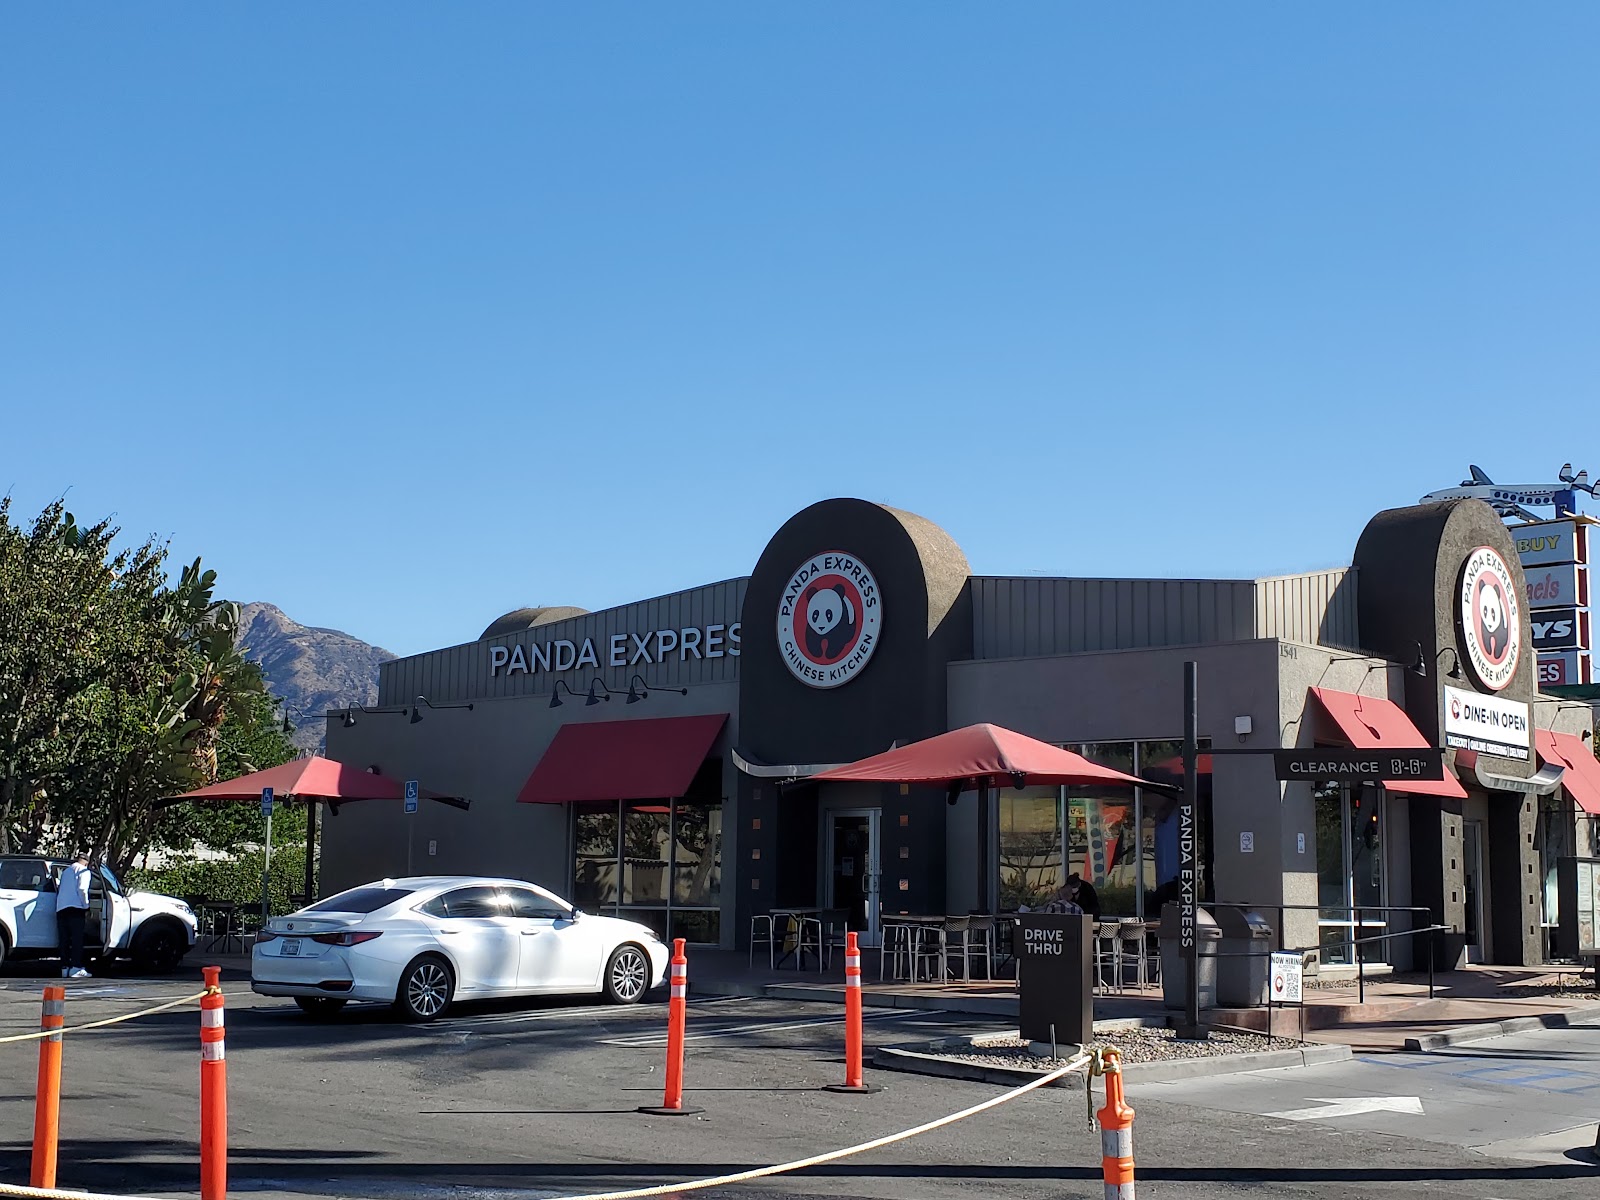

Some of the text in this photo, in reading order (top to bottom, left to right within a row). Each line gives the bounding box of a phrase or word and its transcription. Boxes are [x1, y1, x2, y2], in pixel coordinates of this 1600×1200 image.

[1516, 534, 1561, 554] BUY
[782, 556, 877, 616] PANDA EXPRESS
[1464, 553, 1517, 616] PANDA EXPRESS
[490, 637, 599, 677] PANDA
[784, 634, 873, 681] CHINESE KITCHEN
[1280, 644, 1298, 660] 1541
[1468, 632, 1517, 682] CHINESE KITCHEN
[1464, 704, 1500, 727] DINE-IN
[1501, 712, 1526, 732] OPEN
[1289, 761, 1379, 773] CLEARANCE
[1180, 804, 1193, 948] PANDA EXPRESS
[1024, 928, 1064, 942] DRIVE
[1024, 942, 1063, 956] THRU
[1271, 956, 1302, 965] NOW HIRING
